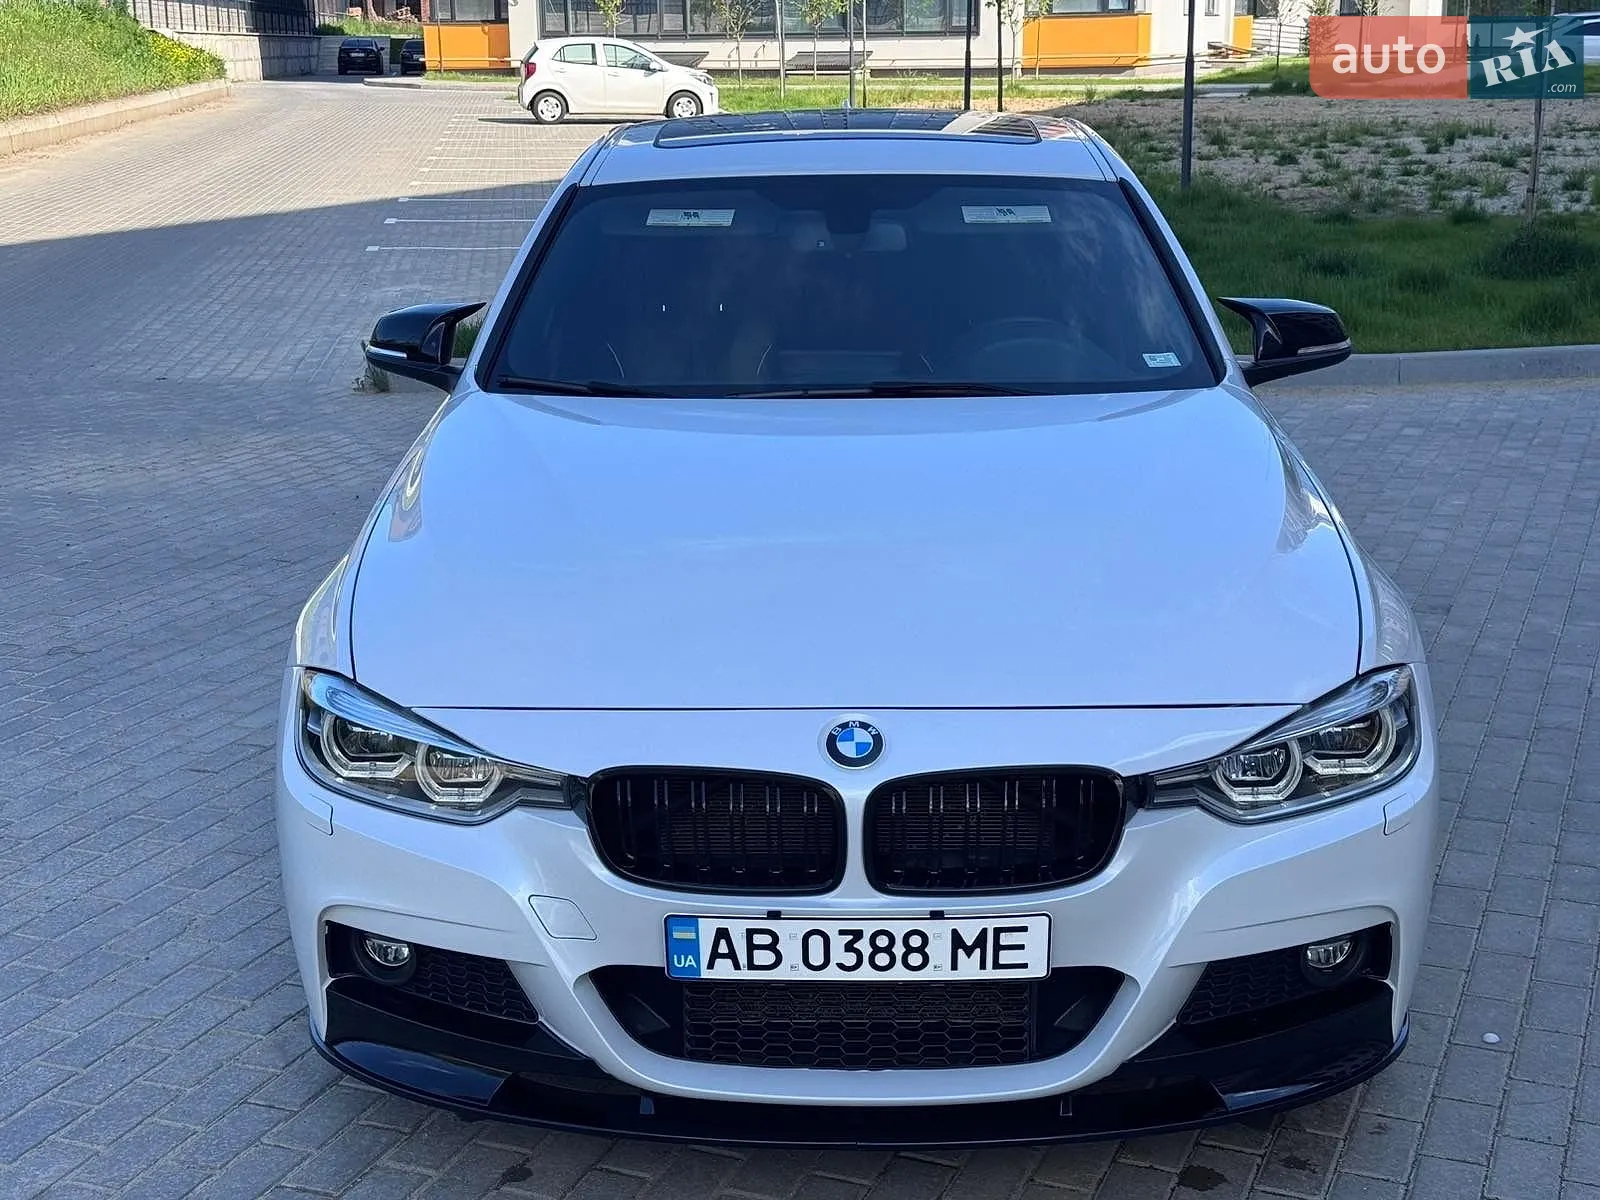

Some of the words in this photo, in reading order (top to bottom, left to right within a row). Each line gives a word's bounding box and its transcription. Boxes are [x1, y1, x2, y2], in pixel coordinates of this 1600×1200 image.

[831, 721, 879, 735] BMW
[706, 927, 783, 971] AB
[801, 928, 930, 972] 0388
[950, 925, 1029, 971] ME
[674, 954, 697, 968] UA
